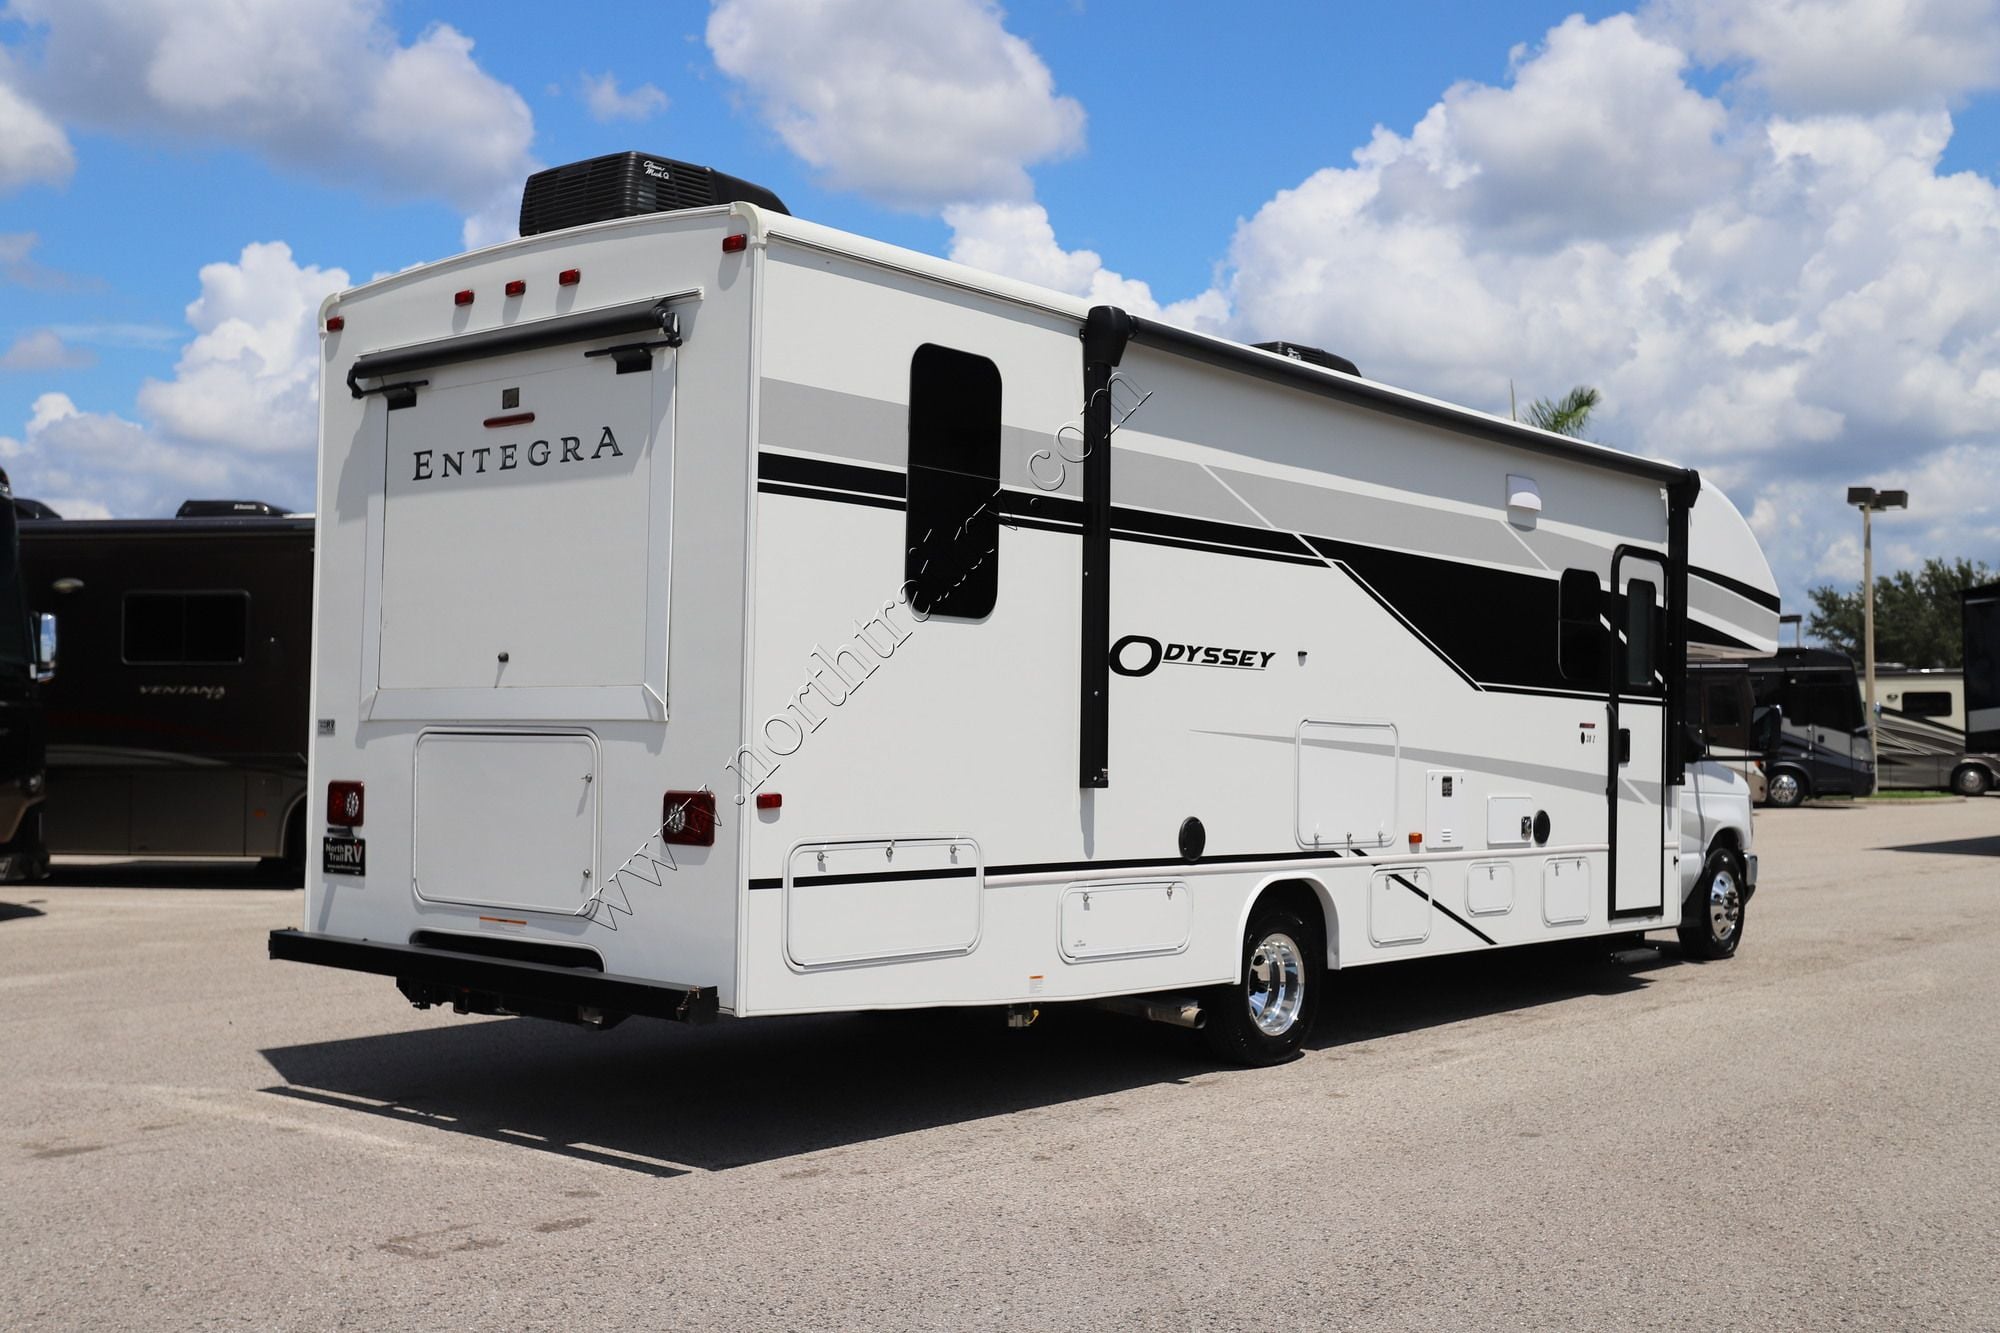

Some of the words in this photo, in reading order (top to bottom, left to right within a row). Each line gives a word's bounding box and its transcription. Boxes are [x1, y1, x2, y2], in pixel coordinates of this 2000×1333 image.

[412, 426, 624, 481] ENTEGRA
[1108, 634, 1277, 678] ODYSSEY
[325, 843, 344, 853] North
[329, 852, 344, 862] Trail
[344, 844, 363, 863] RV
